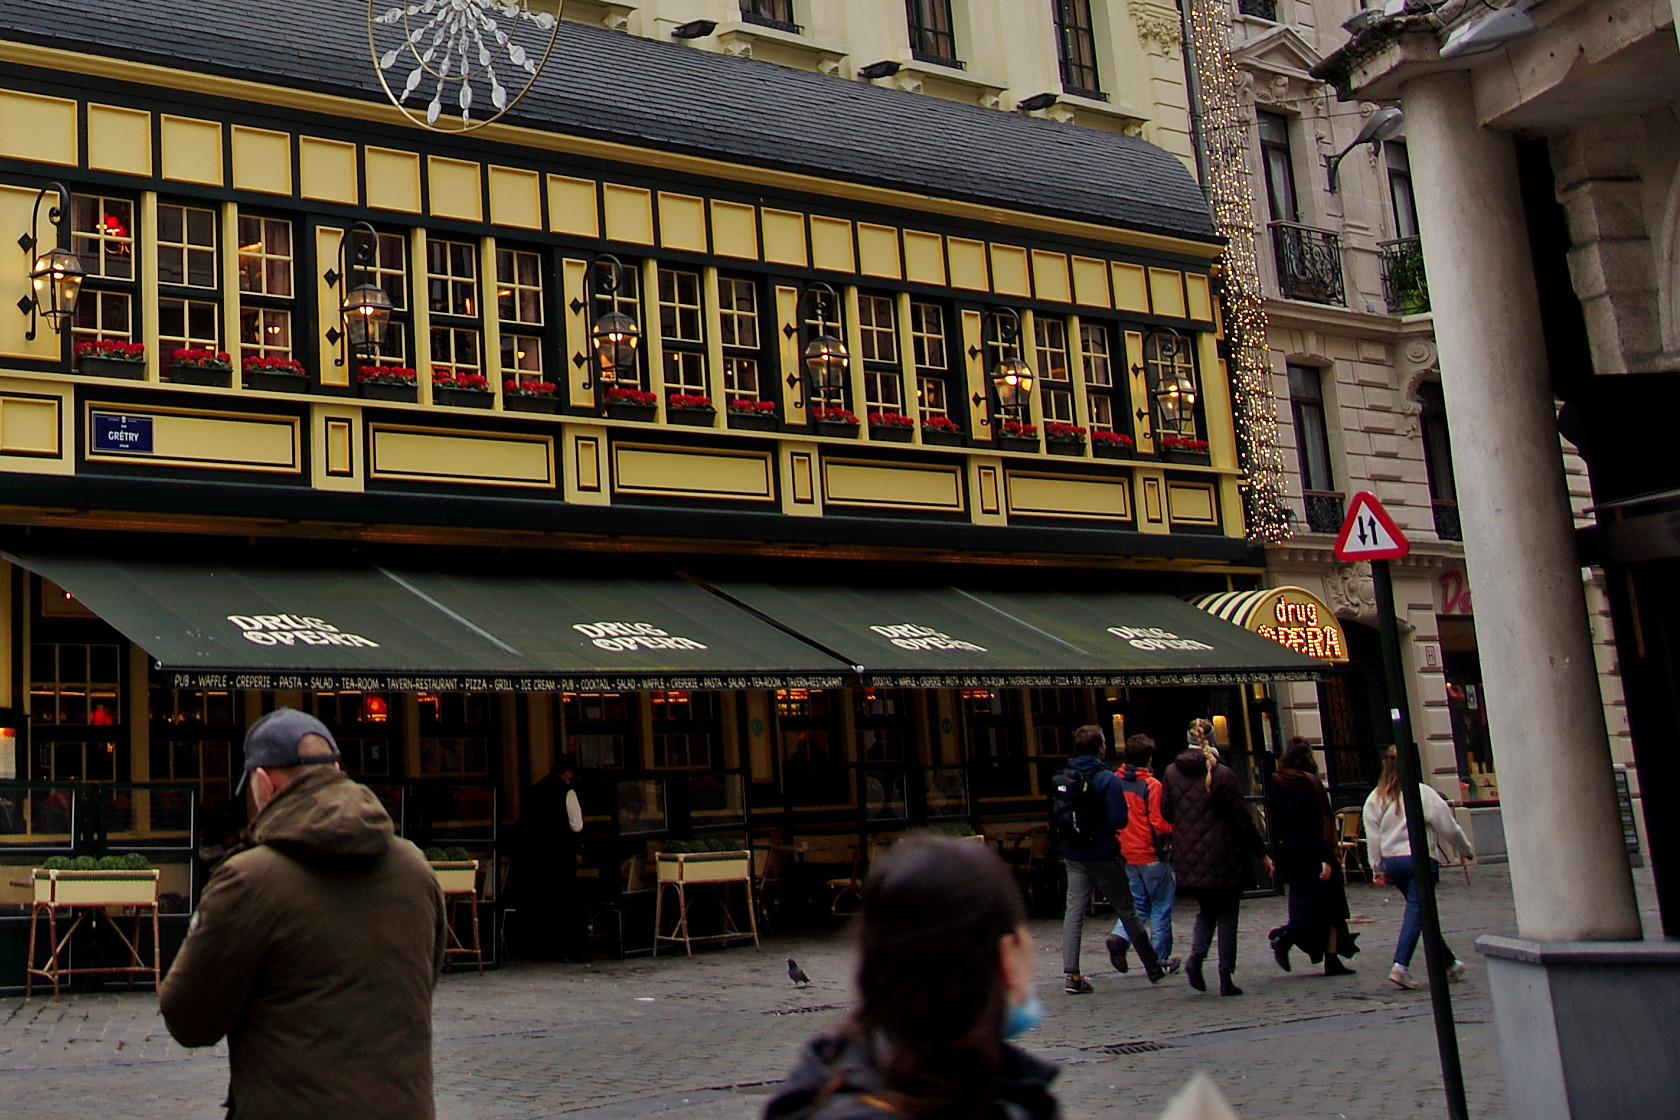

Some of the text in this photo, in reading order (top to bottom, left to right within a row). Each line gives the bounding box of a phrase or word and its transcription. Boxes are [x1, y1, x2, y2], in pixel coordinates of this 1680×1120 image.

[108, 430, 139, 442] GRÉTRY
[1276, 595, 1317, 627] drug
[227, 613, 340, 633] DRUG
[572, 622, 668, 638] DRUG
[243, 630, 380, 648] OPERA
[592, 636, 708, 651] OPERA
[174, 674, 189, 687] PUB
[198, 674, 227, 688] WAFFLE
[279, 676, 302, 688] PASTA
[310, 676, 333, 689] SALAD
[342, 677, 379, 690] TEA-ROOM
[387, 678, 458, 690] TAVERN-RESTAURANT
[465, 678, 487, 690] PIZZA
[494, 678, 513, 690] GRILL
[520, 679, 532, 690] ICE
[533, 679, 556, 690] CREAM
[562, 679, 574, 690] PUB
[580, 679, 611, 690] COCKTAIL
[617, 678, 636, 690] SALAD
[641, 678, 665, 689] WAFFLE
